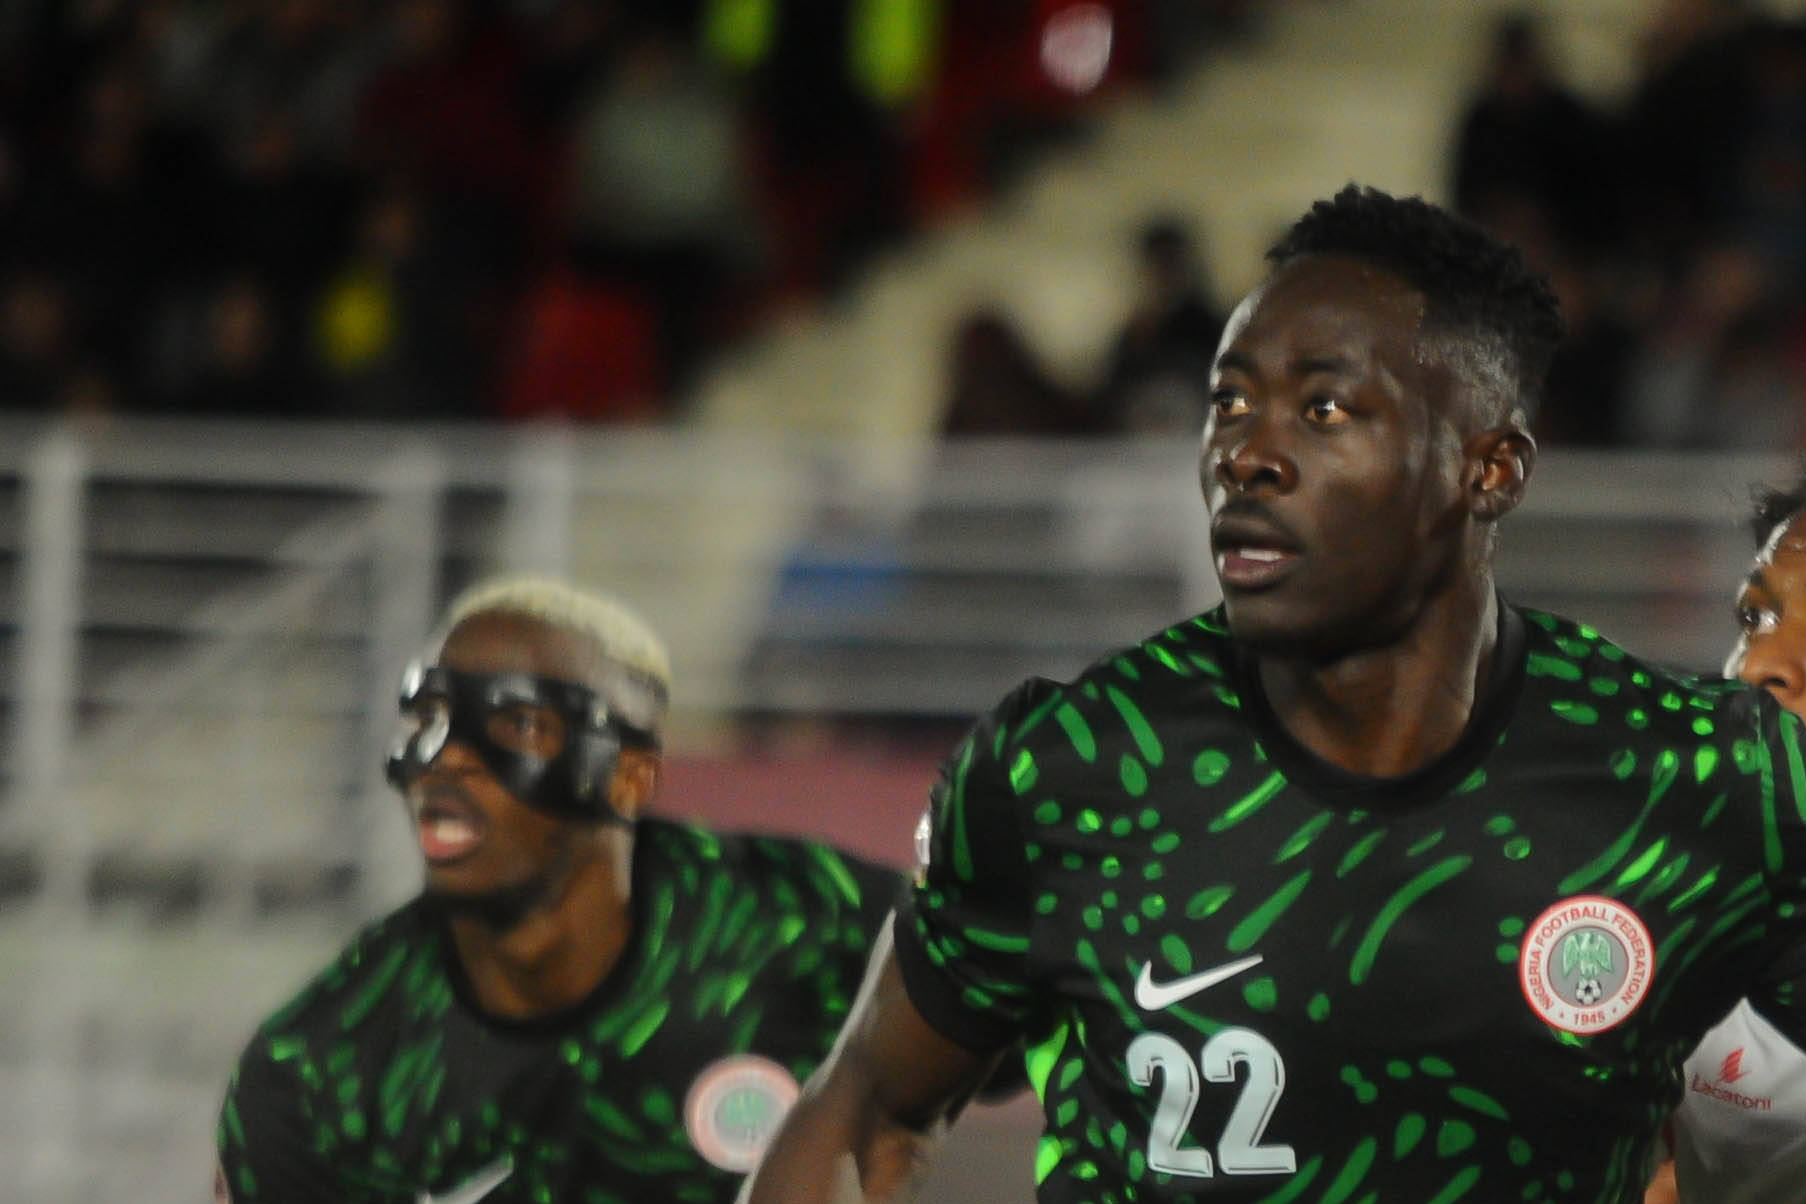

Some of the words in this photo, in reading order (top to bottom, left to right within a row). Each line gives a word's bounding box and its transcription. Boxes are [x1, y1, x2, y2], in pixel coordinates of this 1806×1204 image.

[1535, 905, 1609, 948] FOOTBALL
[1529, 949, 1554, 1010] NIGERIA
[1611, 914, 1647, 1005] FEDERATION
[1573, 1012, 1606, 1026] 1945
[1126, 1026, 1297, 1178] 22
[1690, 1072, 1772, 1112] Lacatoni
